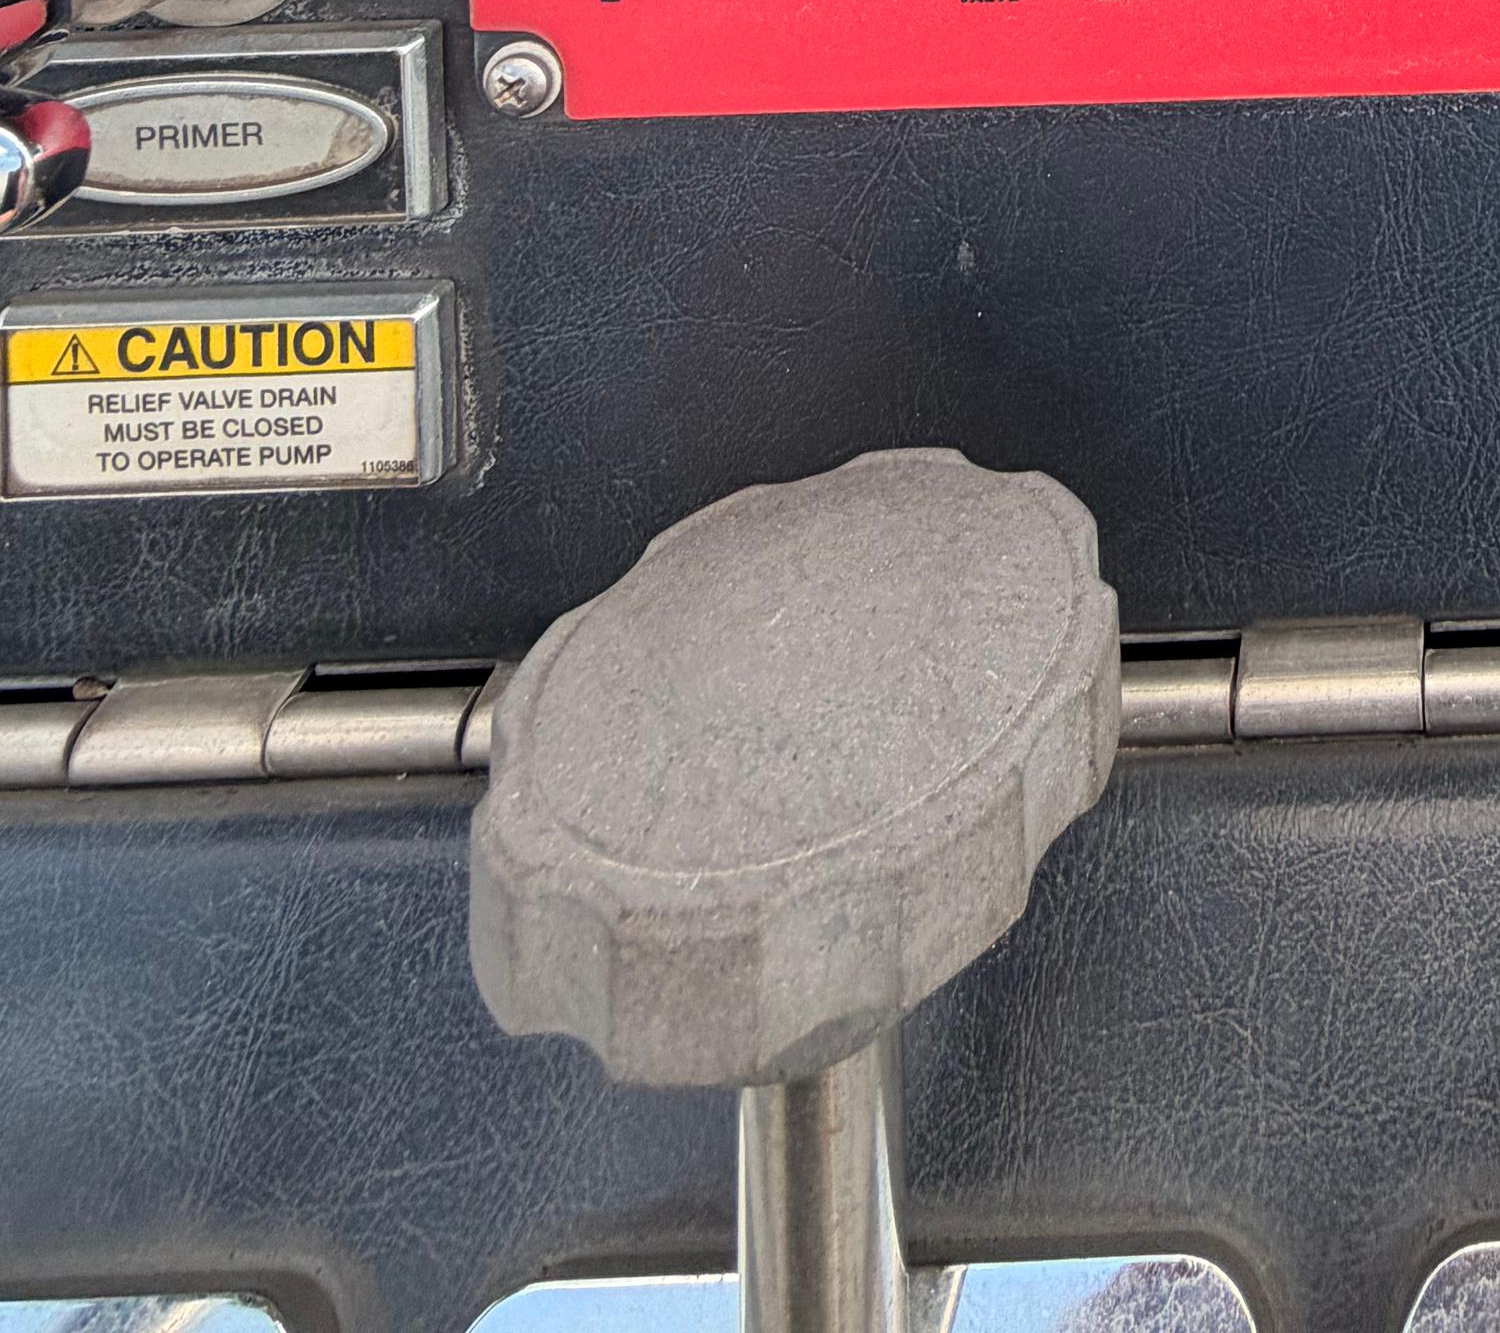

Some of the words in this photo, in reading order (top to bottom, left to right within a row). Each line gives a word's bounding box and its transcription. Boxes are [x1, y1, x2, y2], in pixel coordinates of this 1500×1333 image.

[136, 122, 262, 150] PRIMER
[118, 320, 375, 372] CAUTION
[89, 393, 171, 413] RELIEF
[179, 390, 252, 410] VALVE
[261, 386, 336, 408] DRAIN
[105, 422, 174, 442] MUST
[182, 420, 215, 439] BE
[223, 416, 323, 438] CLOSED
[96, 452, 129, 472] TO
[138, 447, 251, 470] OPERATE
[260, 445, 331, 465] PUMP
